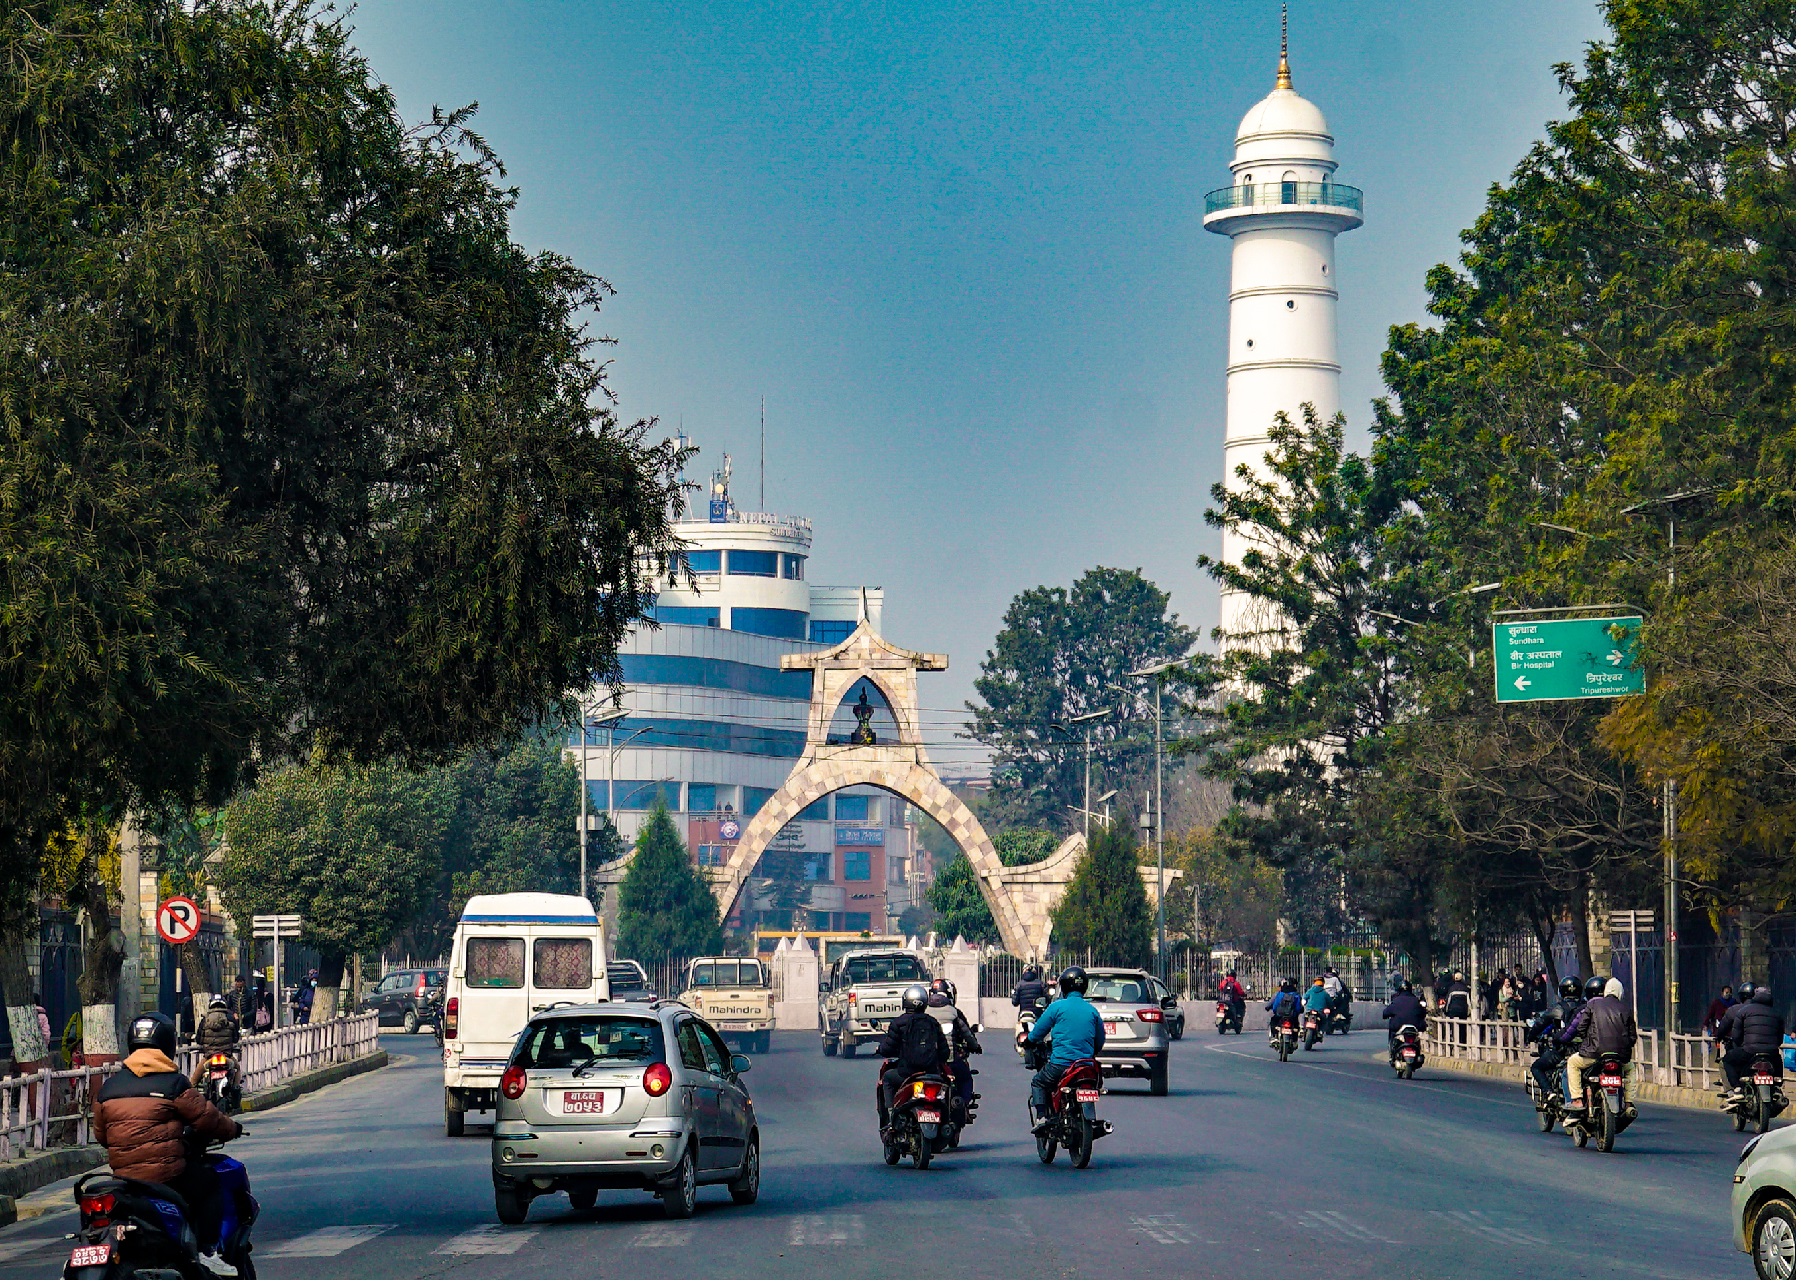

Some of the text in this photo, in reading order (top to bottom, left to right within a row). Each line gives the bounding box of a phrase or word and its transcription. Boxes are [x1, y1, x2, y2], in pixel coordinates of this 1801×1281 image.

[1523, 661, 1555, 670] Hospital
[709, 1006, 762, 1014] Mahindra
[865, 1003, 902, 1013] Mahin
